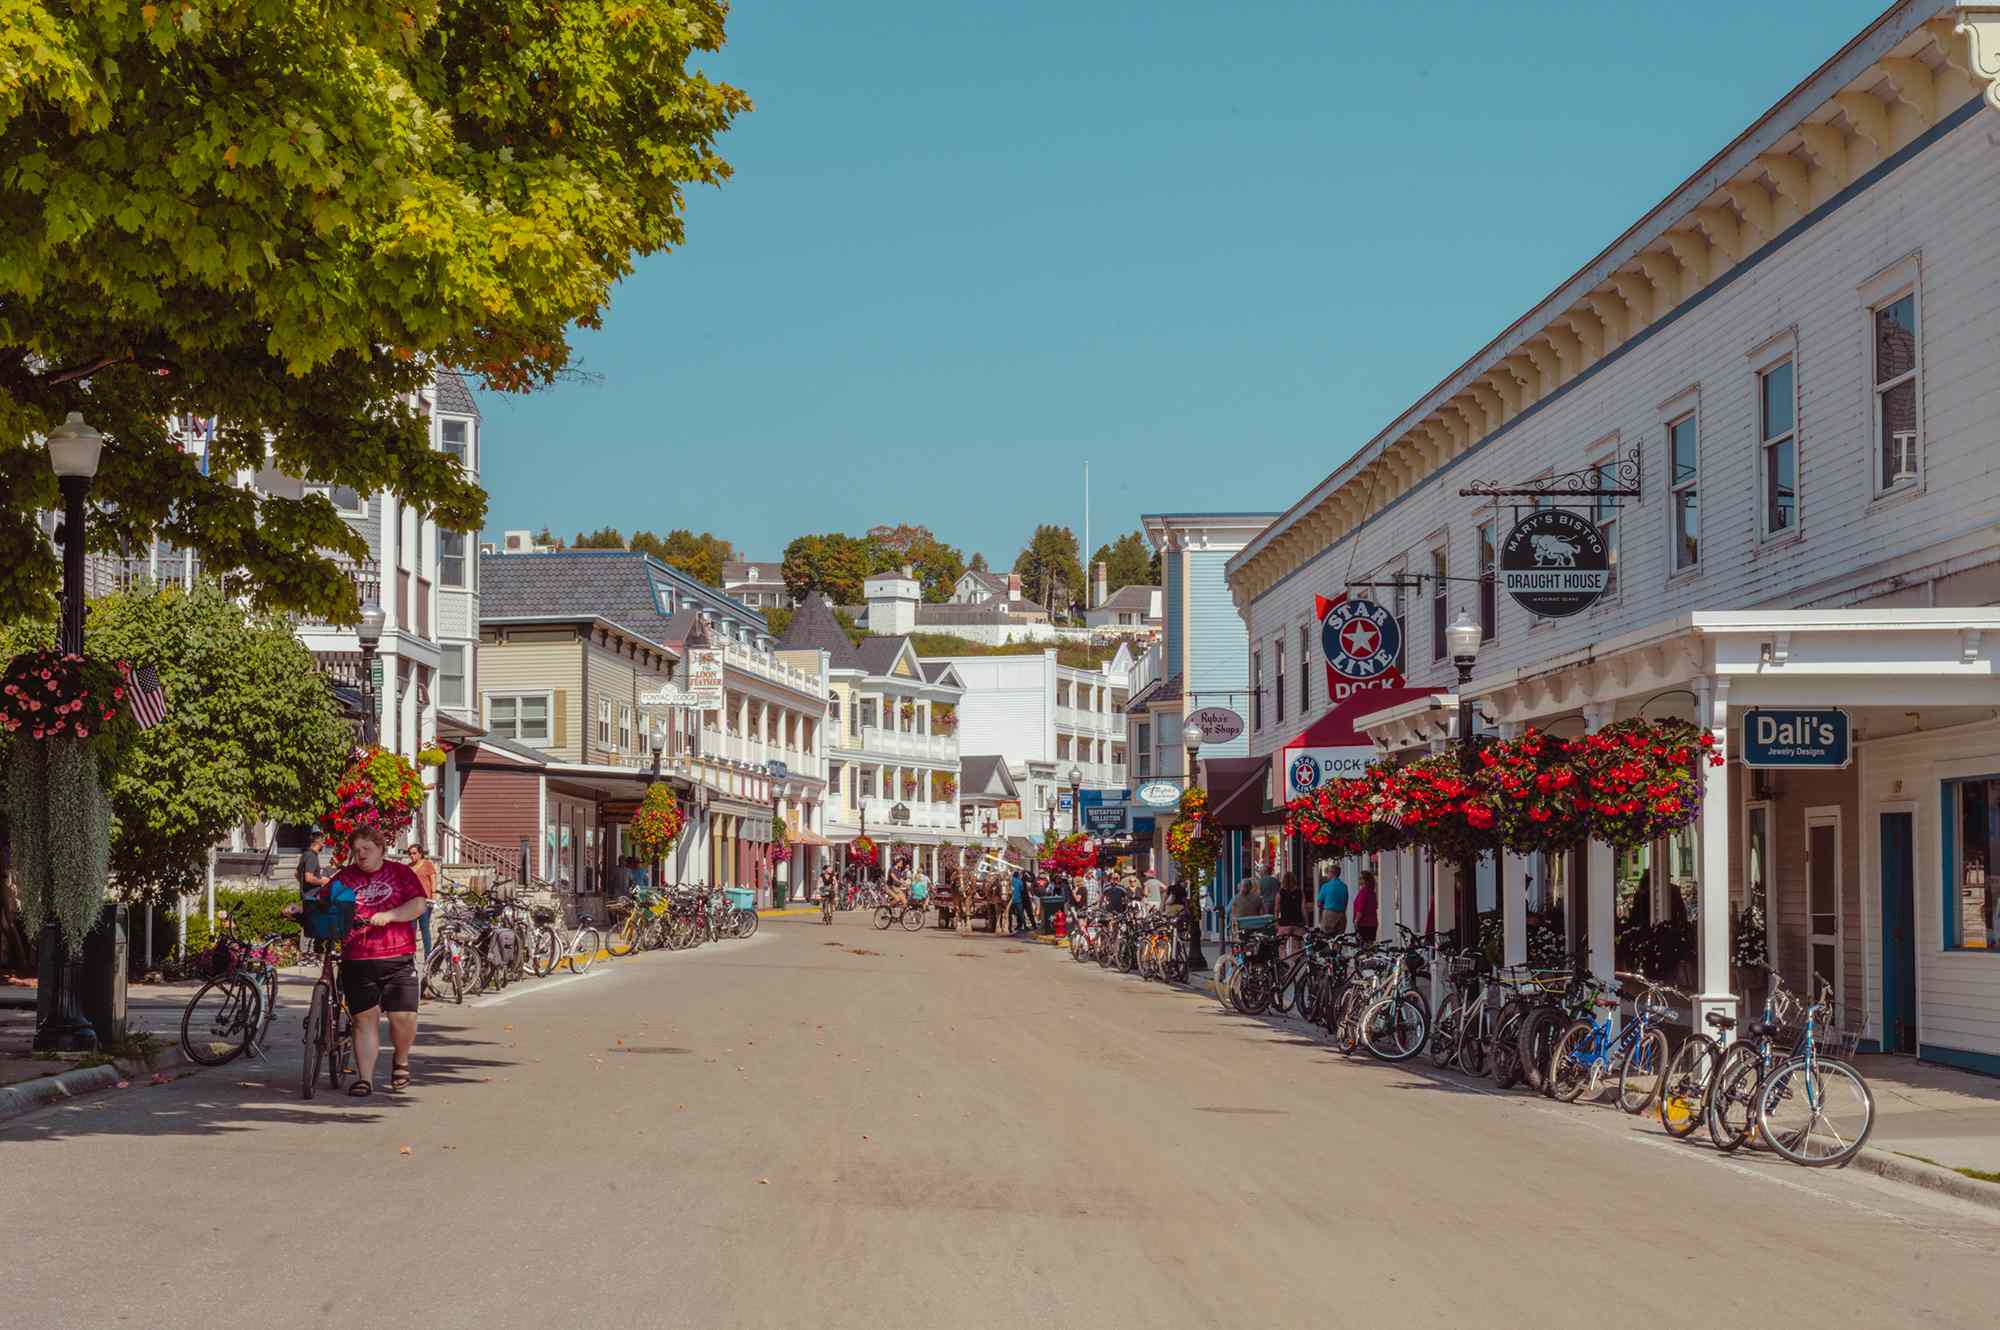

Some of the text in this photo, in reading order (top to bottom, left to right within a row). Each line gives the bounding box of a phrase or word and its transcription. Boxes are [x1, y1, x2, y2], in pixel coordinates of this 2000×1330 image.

[1507, 514, 1602, 554] MARY'S BISTRO
[1507, 574, 1602, 589] DRAUGHT HOUSE
[1328, 602, 1388, 630] STAR
[1331, 649, 1393, 676] LINE
[1757, 716, 1835, 745] Dali's
[1324, 759, 1360, 771] DOCK
[1768, 747, 1825, 757] Jewelry Designs
